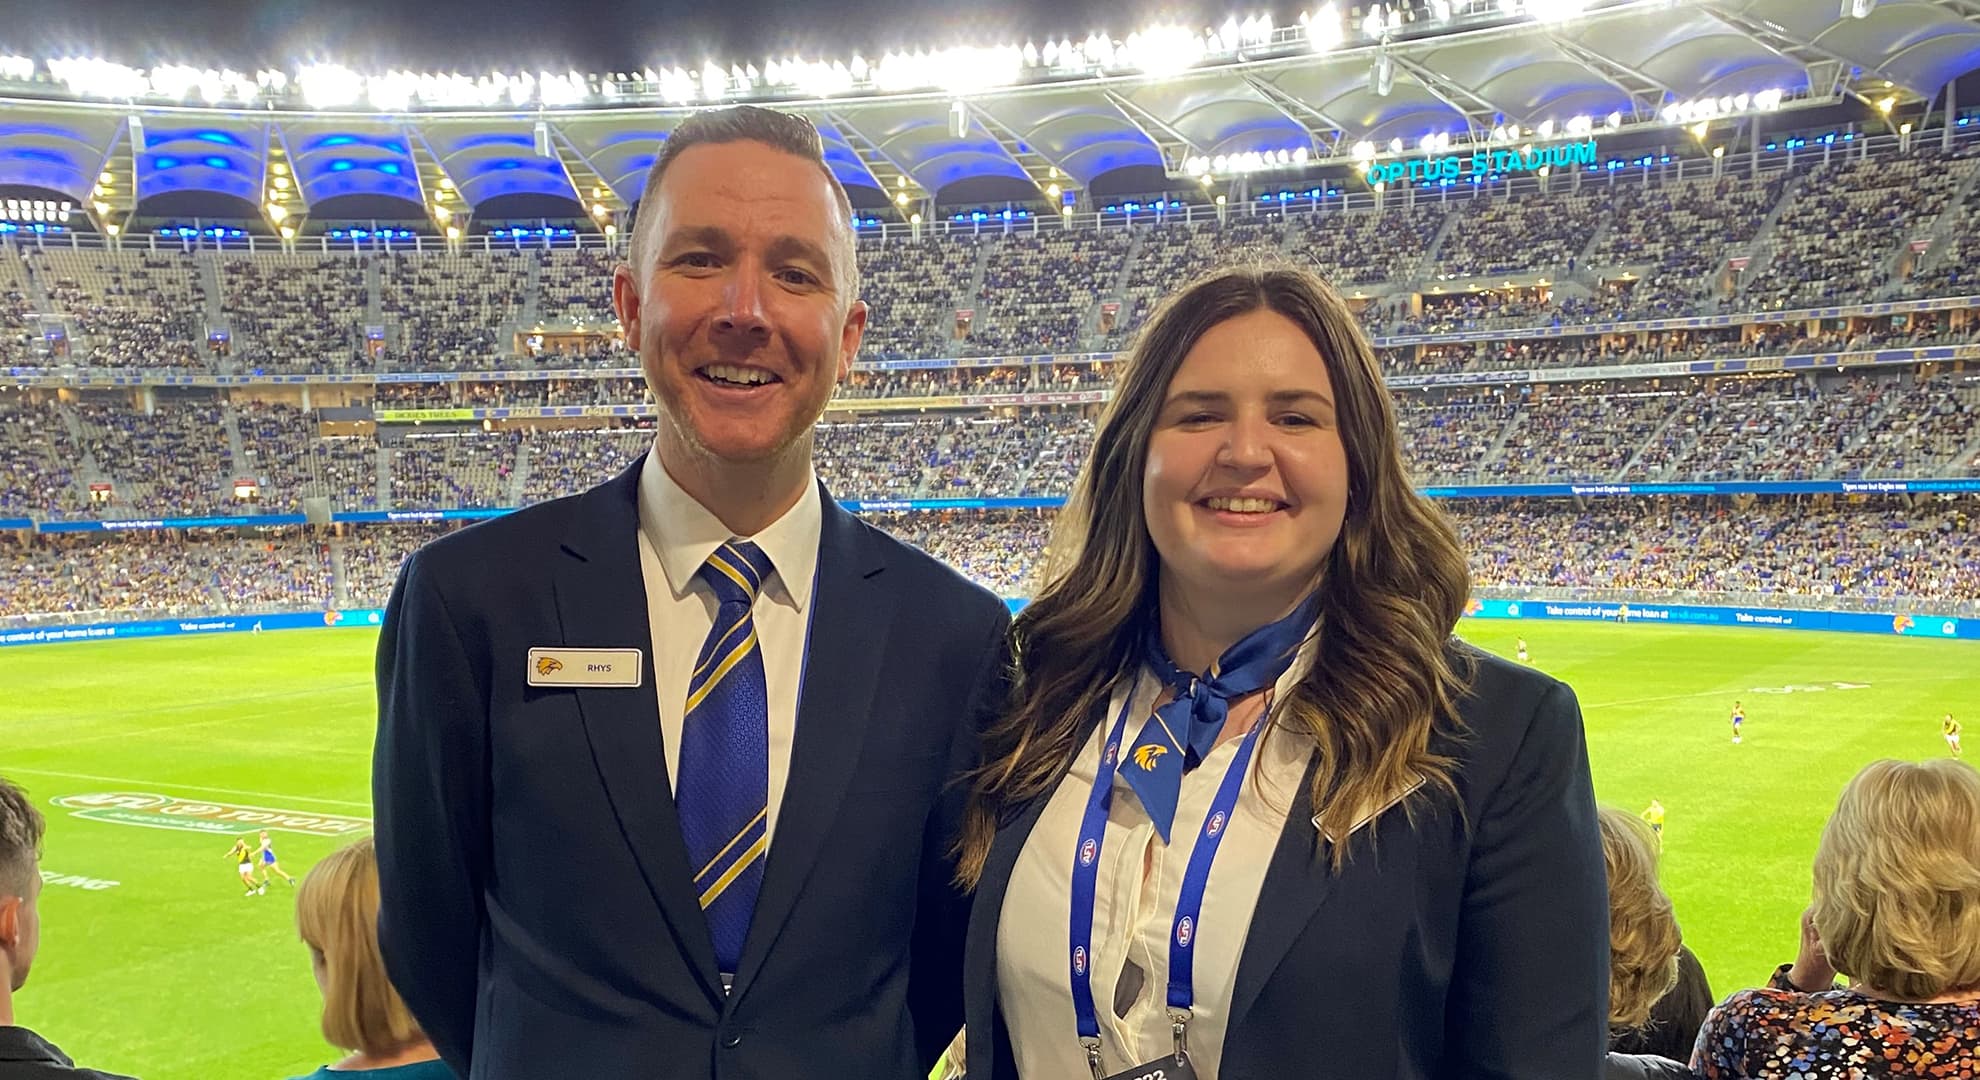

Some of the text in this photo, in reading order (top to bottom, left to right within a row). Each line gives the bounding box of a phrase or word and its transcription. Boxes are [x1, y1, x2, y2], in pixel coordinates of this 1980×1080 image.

[1367, 141, 1597, 185] OPTUS STADIUM
[1546, 606, 1563, 615] Take
[1564, 607, 1592, 616] control
[1592, 607, 1601, 616] of
[1601, 608, 1619, 618] your
[1642, 609, 1660, 618] loan
[1660, 610, 1668, 619] at
[1736, 613, 1754, 622] Take
[1754, 615, 1783, 624] control
[6, 631, 35, 642] control
[35, 630, 45, 640] of
[45, 631, 64, 641] your
[64, 629, 88, 638] home
[87, 627, 106, 636] loan
[587, 664, 612, 672] RHYS
[1207, 813, 1223, 836] AFL
[1081, 840, 1094, 865] AFL
[1178, 918, 1190, 945] AFL
[1075, 948, 1085, 974] AFL
